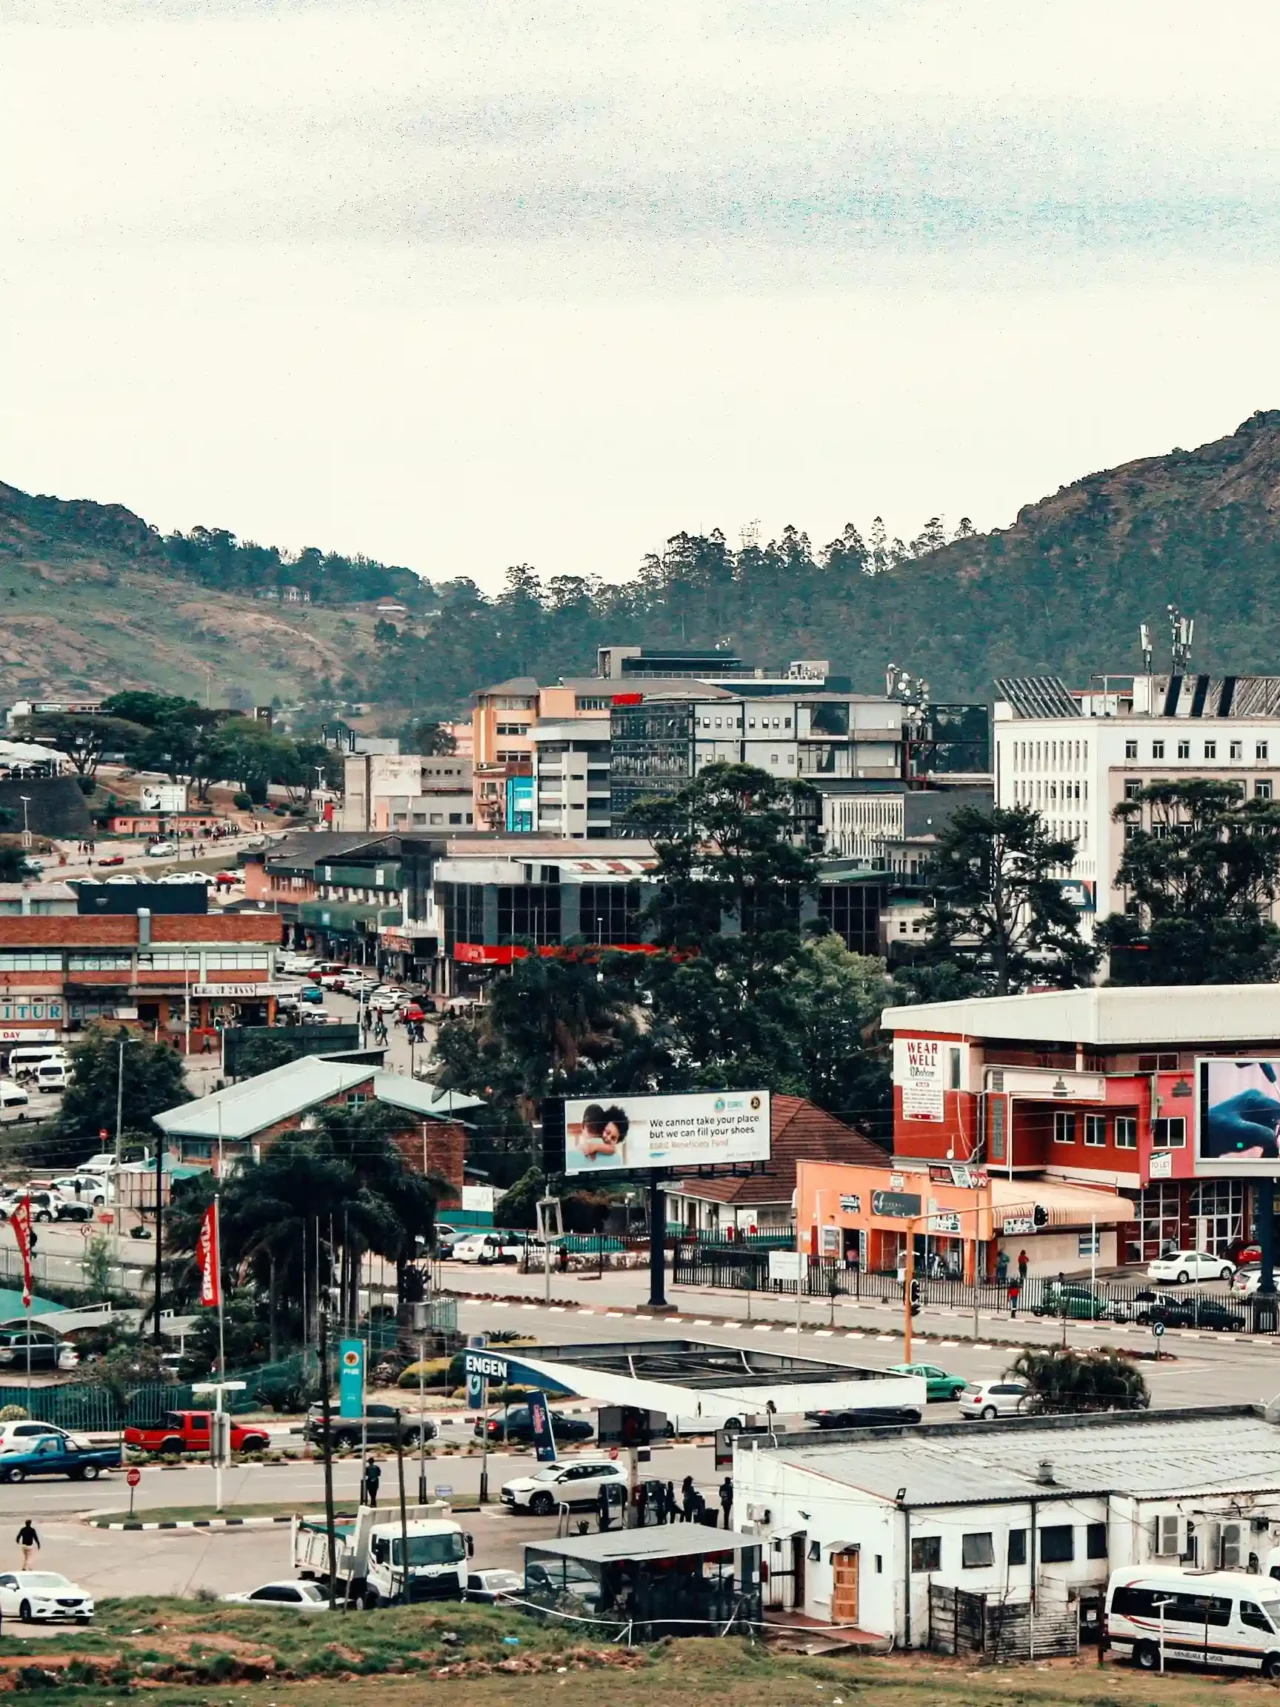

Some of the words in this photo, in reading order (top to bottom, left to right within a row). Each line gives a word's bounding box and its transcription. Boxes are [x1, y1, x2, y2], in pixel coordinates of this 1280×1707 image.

[907, 1042, 938, 1054] WEAR
[909, 1054, 936, 1066] WELL
[666, 1119, 694, 1127] cannot
[696, 1117, 715, 1125] take
[716, 1117, 735, 1127] your
[737, 1115, 759, 1124] place
[650, 1130, 664, 1139] but
[697, 1128, 709, 1136] fill
[710, 1129, 728, 1138] your
[731, 1126, 755, 1135] shoes
[1151, 1161, 1159, 1169] TO
[466, 1355, 507, 1378] ENGEN
